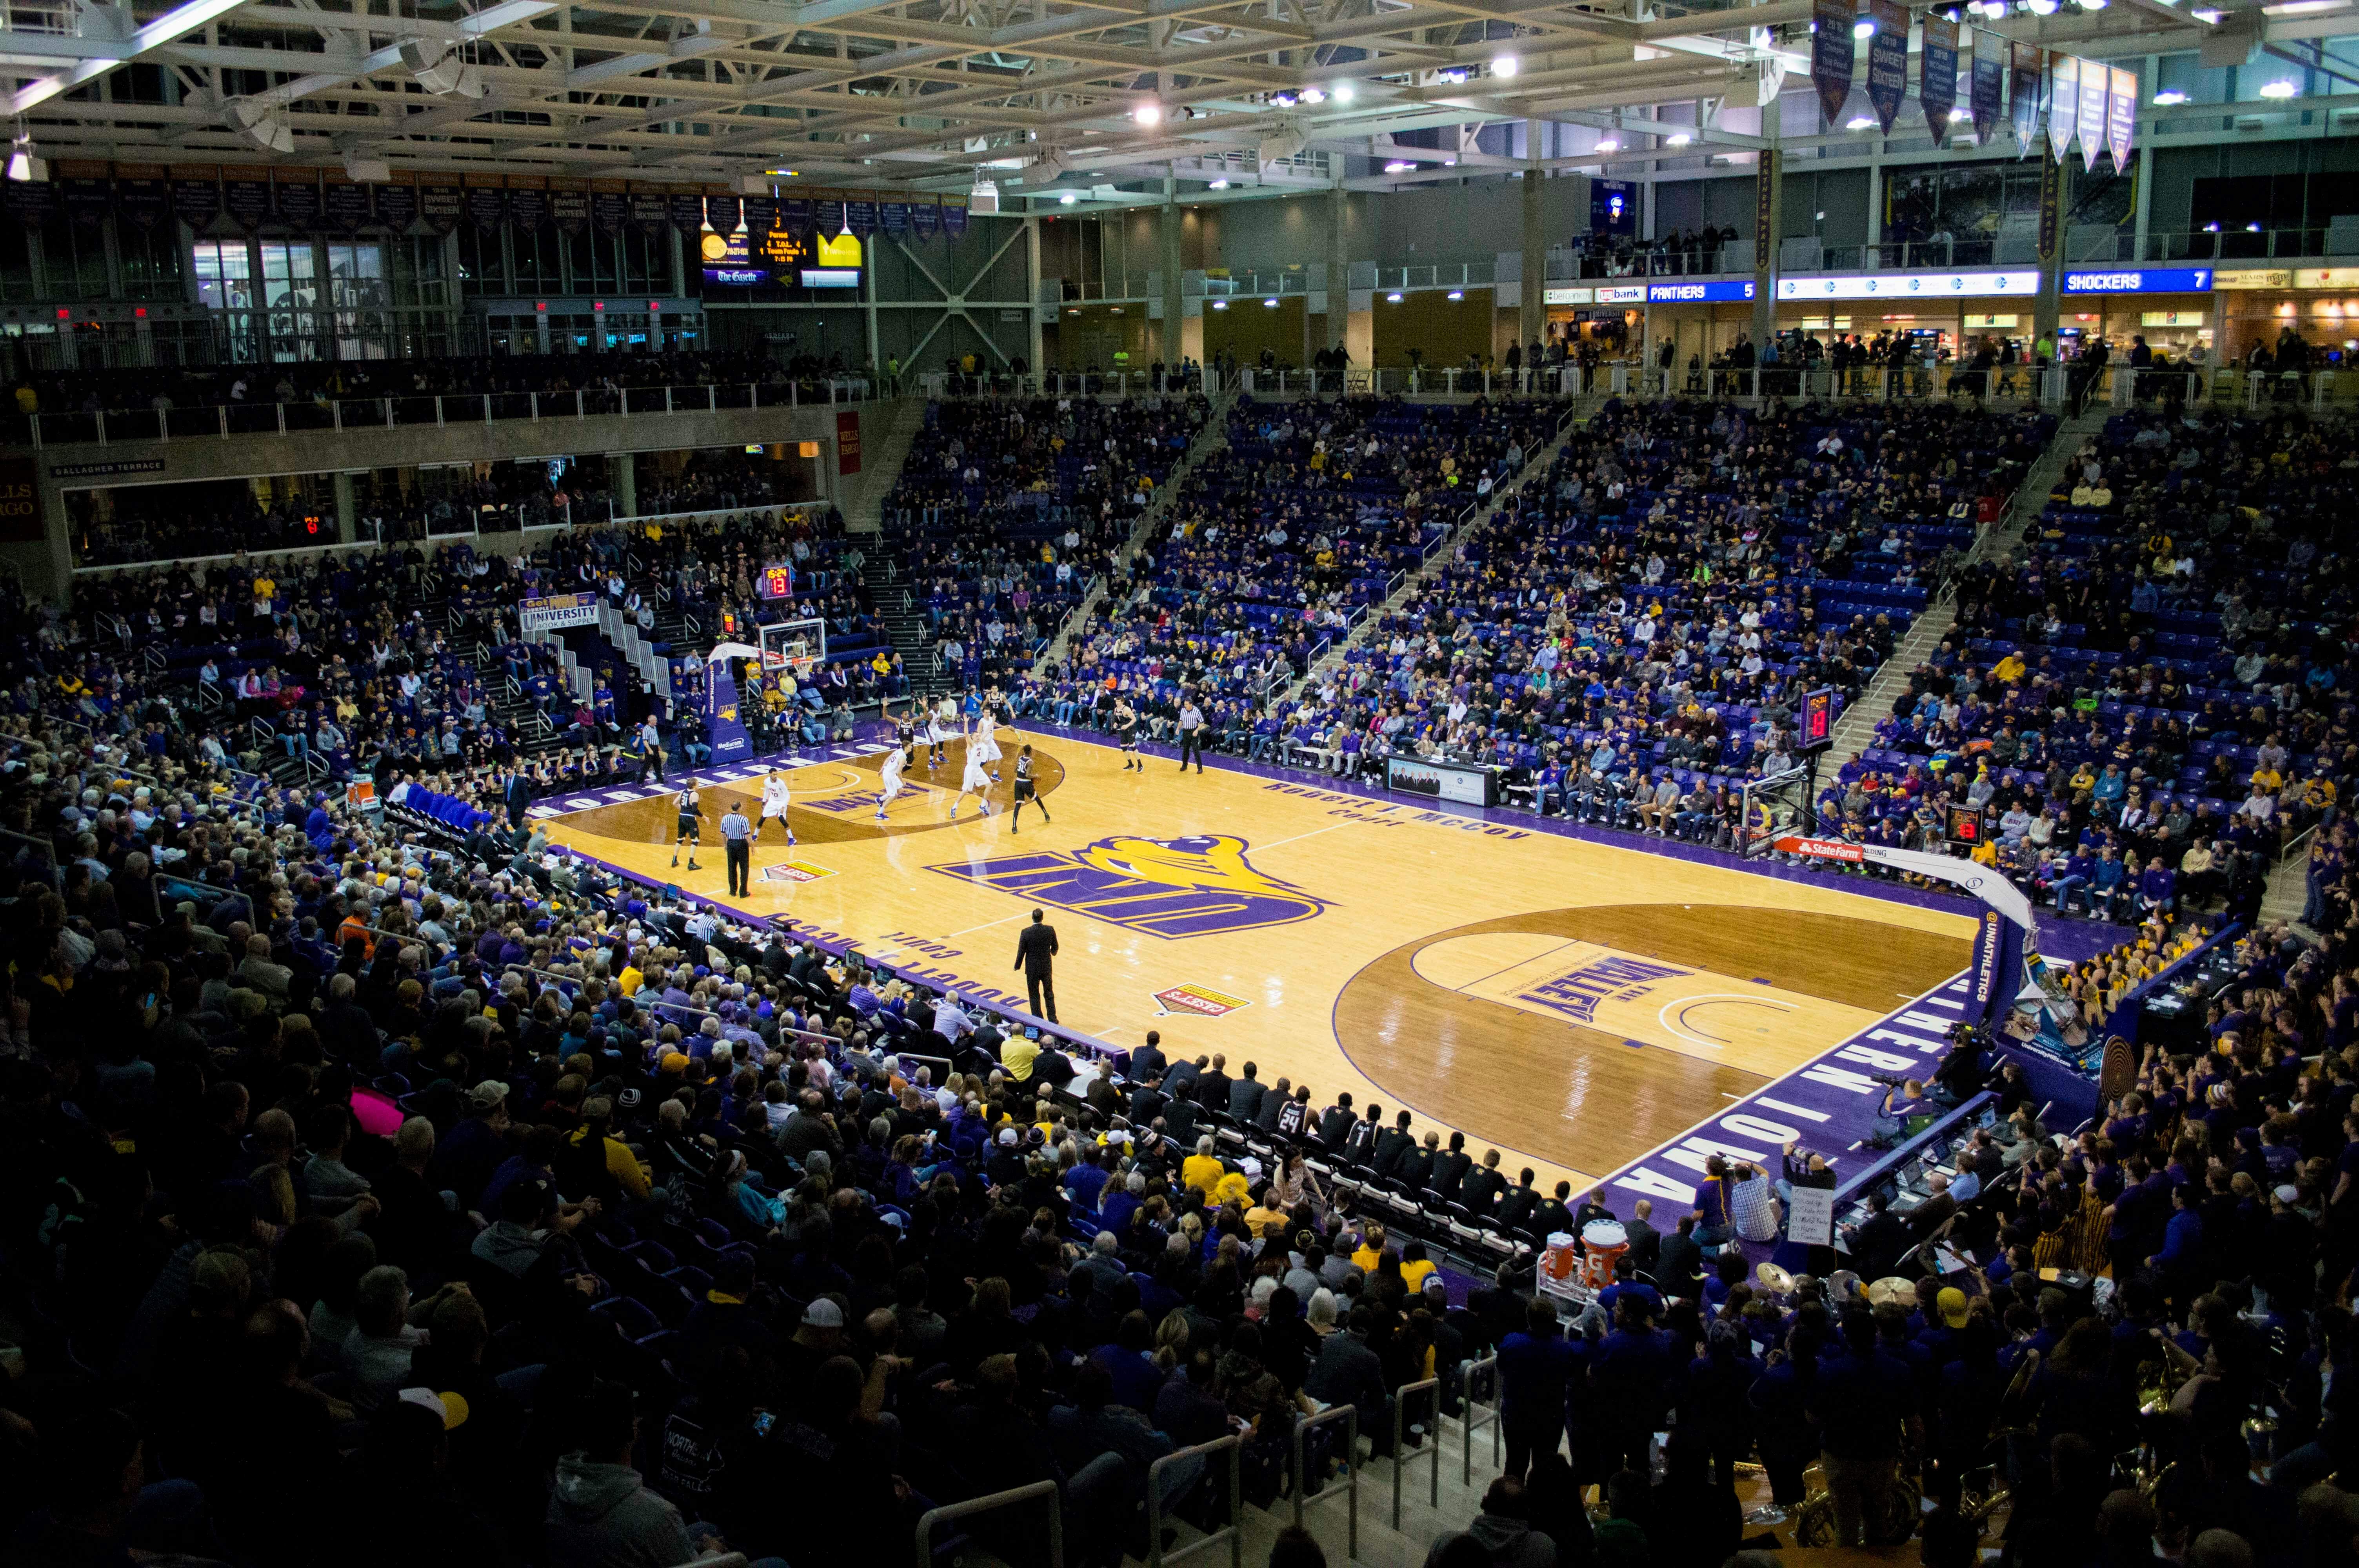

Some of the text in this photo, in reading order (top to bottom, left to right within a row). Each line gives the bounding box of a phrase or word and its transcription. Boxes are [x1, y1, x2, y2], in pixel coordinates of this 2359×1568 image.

[1873, 47, 1905, 69] SWEET
[1872, 67, 1903, 90] SIXTEEN
[425, 195, 458, 203] SWEET
[425, 205, 459, 214] SIXTEEN
[554, 209, 586, 217] SIXTEEN
[635, 211, 665, 220] SIXTEEN
[718, 271, 758, 282] The Gazette
[2068, 274, 2140, 290] SHOCKERS
[2194, 272, 2205, 289] 7
[1650, 285, 1705, 300] PANTHERS
[1744, 284, 1753, 297] 5
[840, 430, 858, 442] WELLS
[55, 461, 161, 476] GALLAGHER TERRACE
[767, 568, 787, 579] 15:24
[772, 577, 785, 594] 13
[526, 598, 549, 608] Get
[523, 606, 596, 631] UNIVERSITY
[537, 621, 559, 630] BOOK
[567, 617, 595, 626] SUPPLY
[718, 739, 742, 750] Mediacom
[681, 796, 688, 807] 31
[1262, 782, 1375, 809] Robert
[1410, 812, 1532, 840] McCoy
[1326, 808, 1405, 827] Court
[878, 931, 964, 960] Court
[1977, 911, 1998, 1003] @UNIATHLETICS
[1499, 952, 1604, 998] MISSOURI VALLEY CONFERENCE
[1516, 955, 1695, 1023] VALLEY
[1610, 985, 1657, 1003] THE
[1166, 991, 1227, 1013] CASEY'S
[1279, 1112, 1301, 1134] 24
[1355, 1132, 1364, 1147] 1
[1548, 1250, 1556, 1259] G
[1588, 1254, 1602, 1271] G
